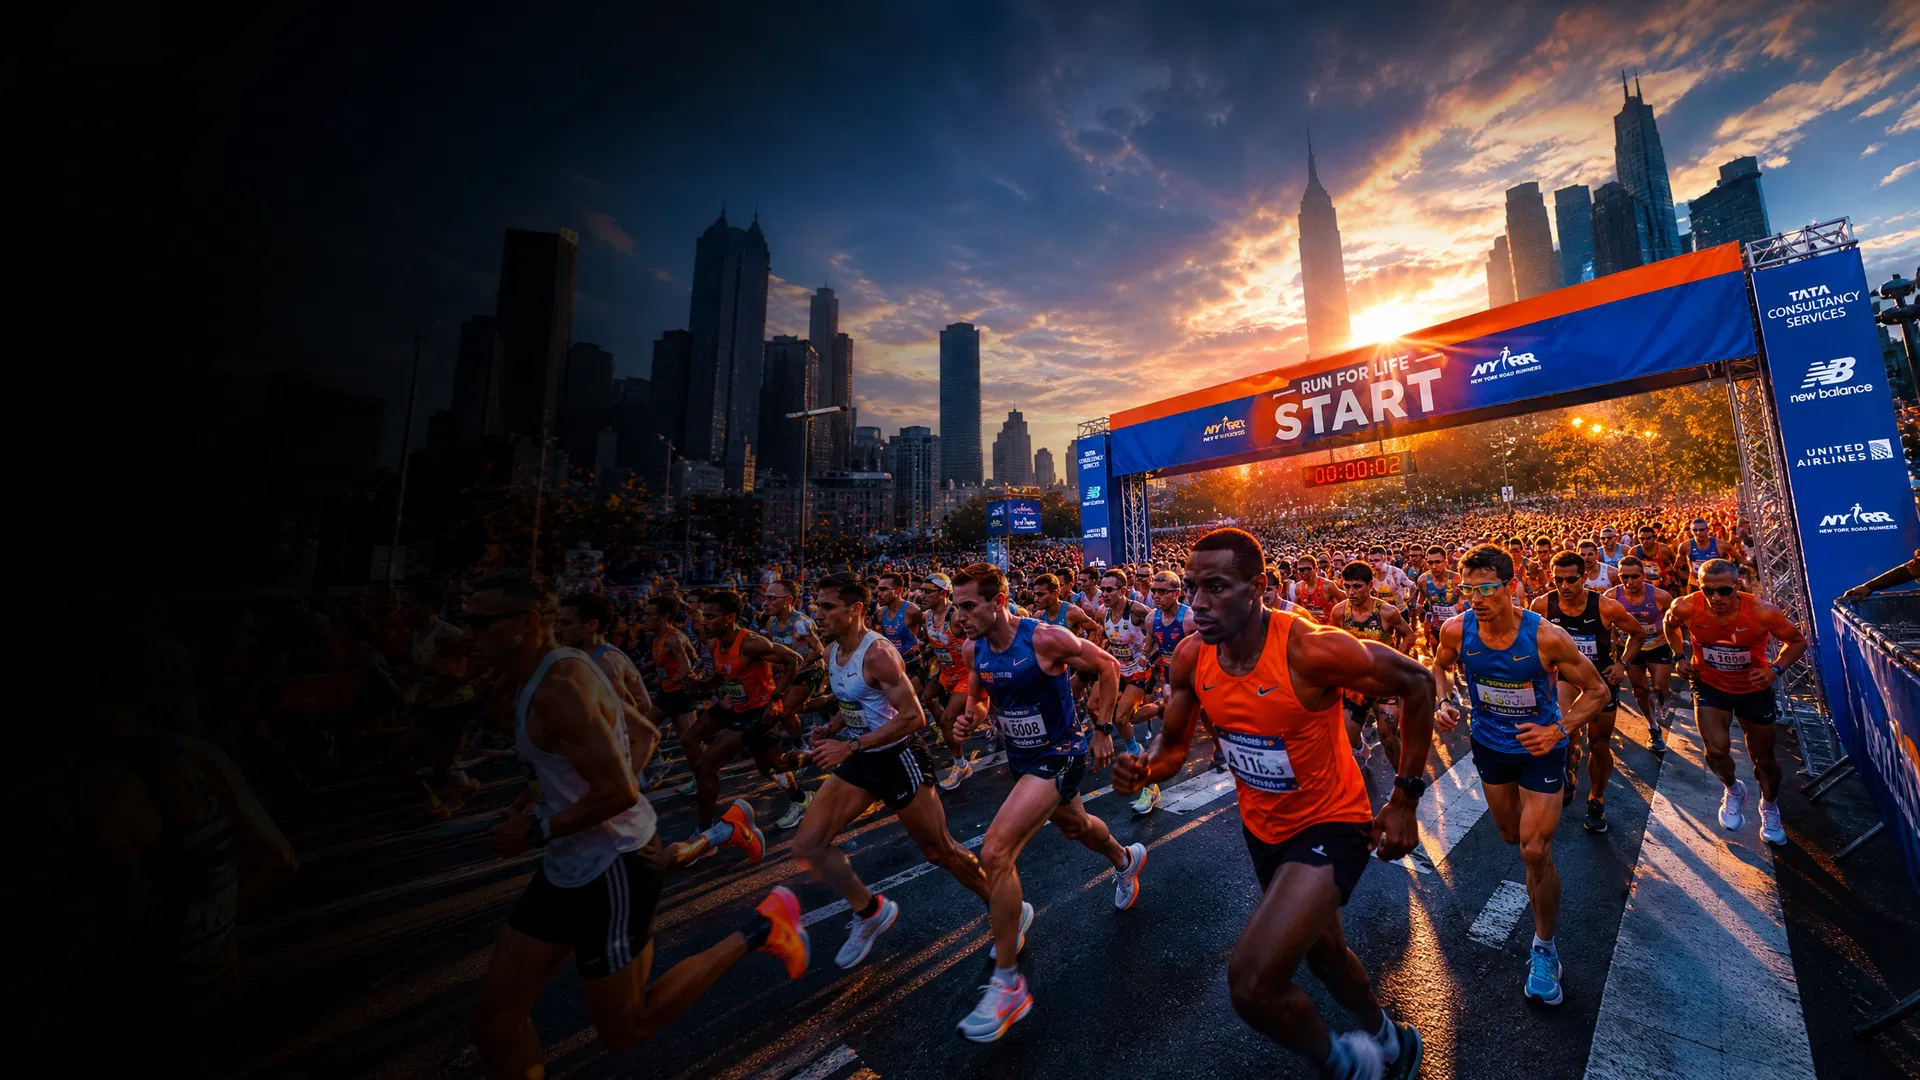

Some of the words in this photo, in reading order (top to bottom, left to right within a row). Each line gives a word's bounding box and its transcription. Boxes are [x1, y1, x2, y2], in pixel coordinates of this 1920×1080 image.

[1788, 284, 1831, 302] TATA
[1767, 290, 1860, 319] CONSULTANCY
[1786, 306, 1847, 328] SERVICES
[1301, 375, 1332, 394] RUN
[1337, 366, 1369, 386] FOR
[1374, 355, 1409, 377] LIFE
[1483, 374, 1499, 382] YORK
[1790, 391, 1817, 403] new
[1818, 383, 1873, 399] balance
[1274, 367, 1442, 441] START
[1796, 452, 1867, 468] AIRLINES
[1806, 443, 1864, 457] UNITED
[1315, 455, 1401, 484] 00:00:02
[1011, 721, 1040, 737] 6008
